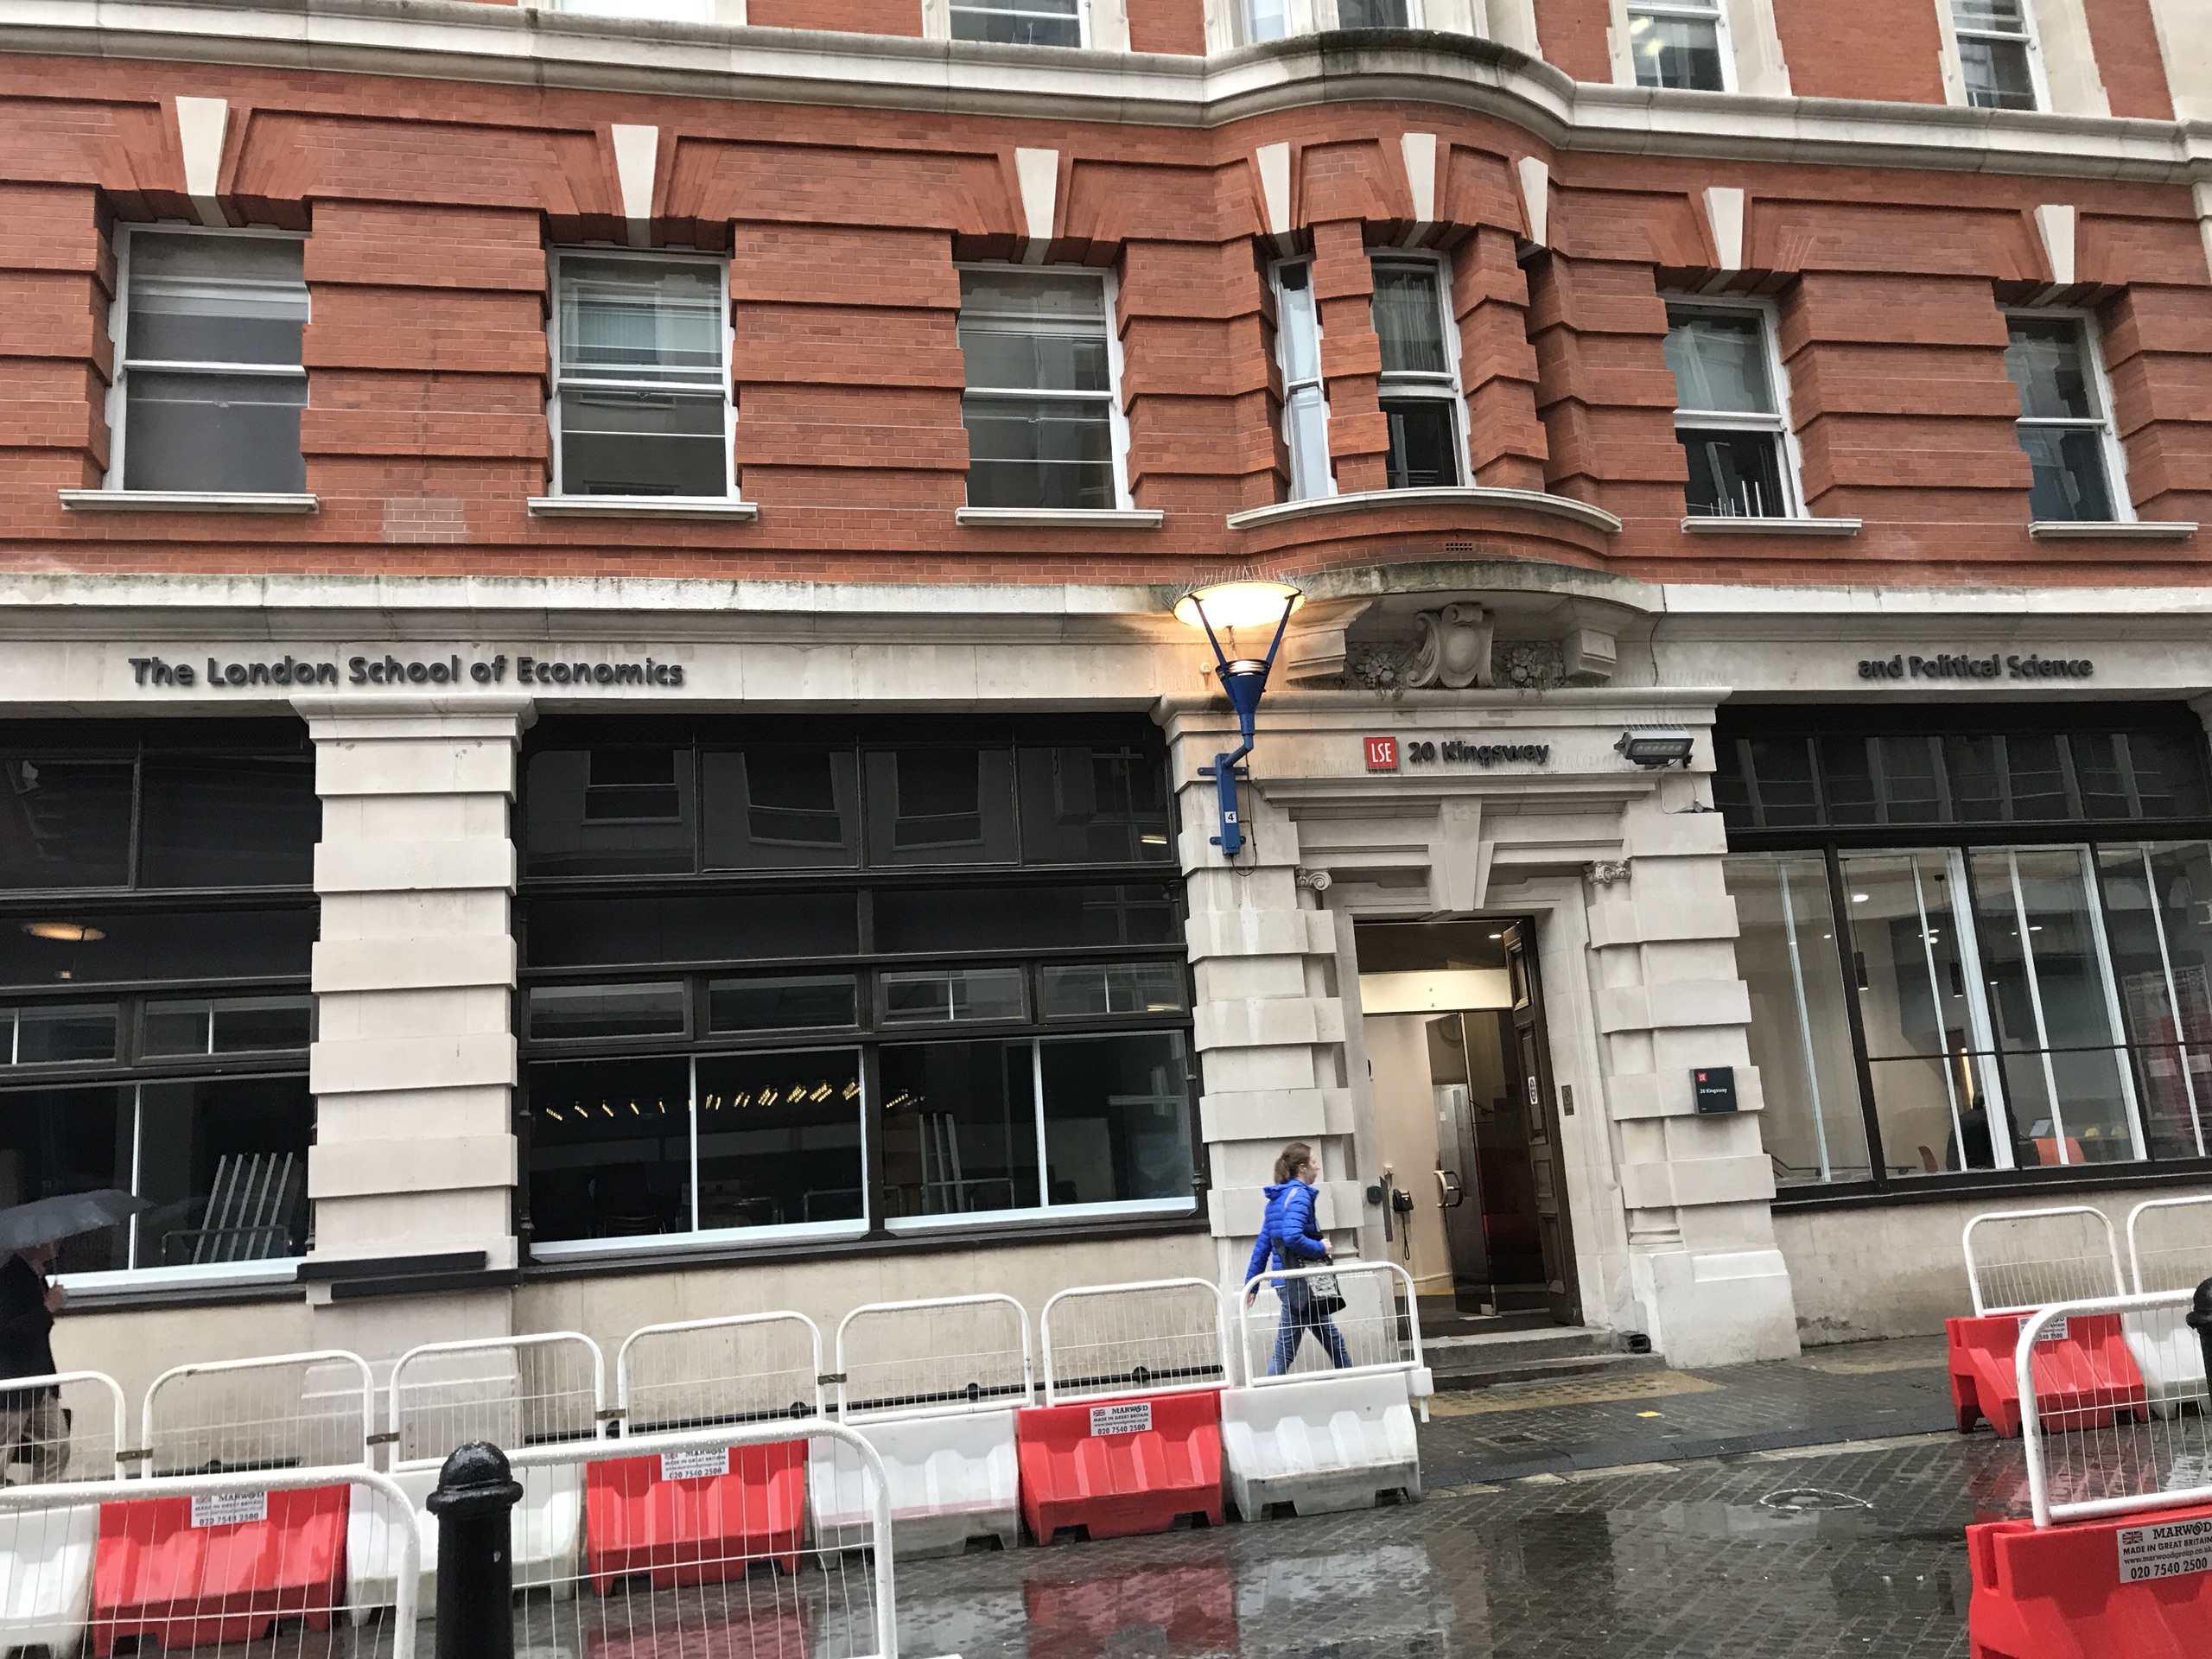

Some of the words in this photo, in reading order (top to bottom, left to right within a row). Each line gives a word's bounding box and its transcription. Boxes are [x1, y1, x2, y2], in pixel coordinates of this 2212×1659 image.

[129, 657, 194, 684] The
[207, 655, 338, 685] London
[349, 654, 459, 684] School
[470, 654, 505, 683] of
[517, 656, 684, 684] Economics
[1858, 654, 1904, 679] and
[1909, 654, 2002, 679] Political
[2006, 654, 2094, 677] Science
[1370, 742, 1393, 763] LSE
[1408, 741, 1436, 764] 20
[1441, 740, 1550, 766] Kingsway
[1227, 813, 1235, 822] 4
[1129, 1423, 1146, 1432] 2500
[705, 1466, 722, 1476] 2500
[2152, 1521, 2212, 1540] MARWOOD
[2123, 1545, 2145, 1555] MADE
[2158, 1541, 2183, 1551] GREAT
[2183, 1536, 2212, 1547] BRITAIN
[2124, 1546, 2212, 1565] www.marwoodgroup.co.uk
[2130, 1566, 2151, 1580] 020
[2153, 1561, 2180, 1577] 7540
[2183, 1557, 2208, 1573] 2500
